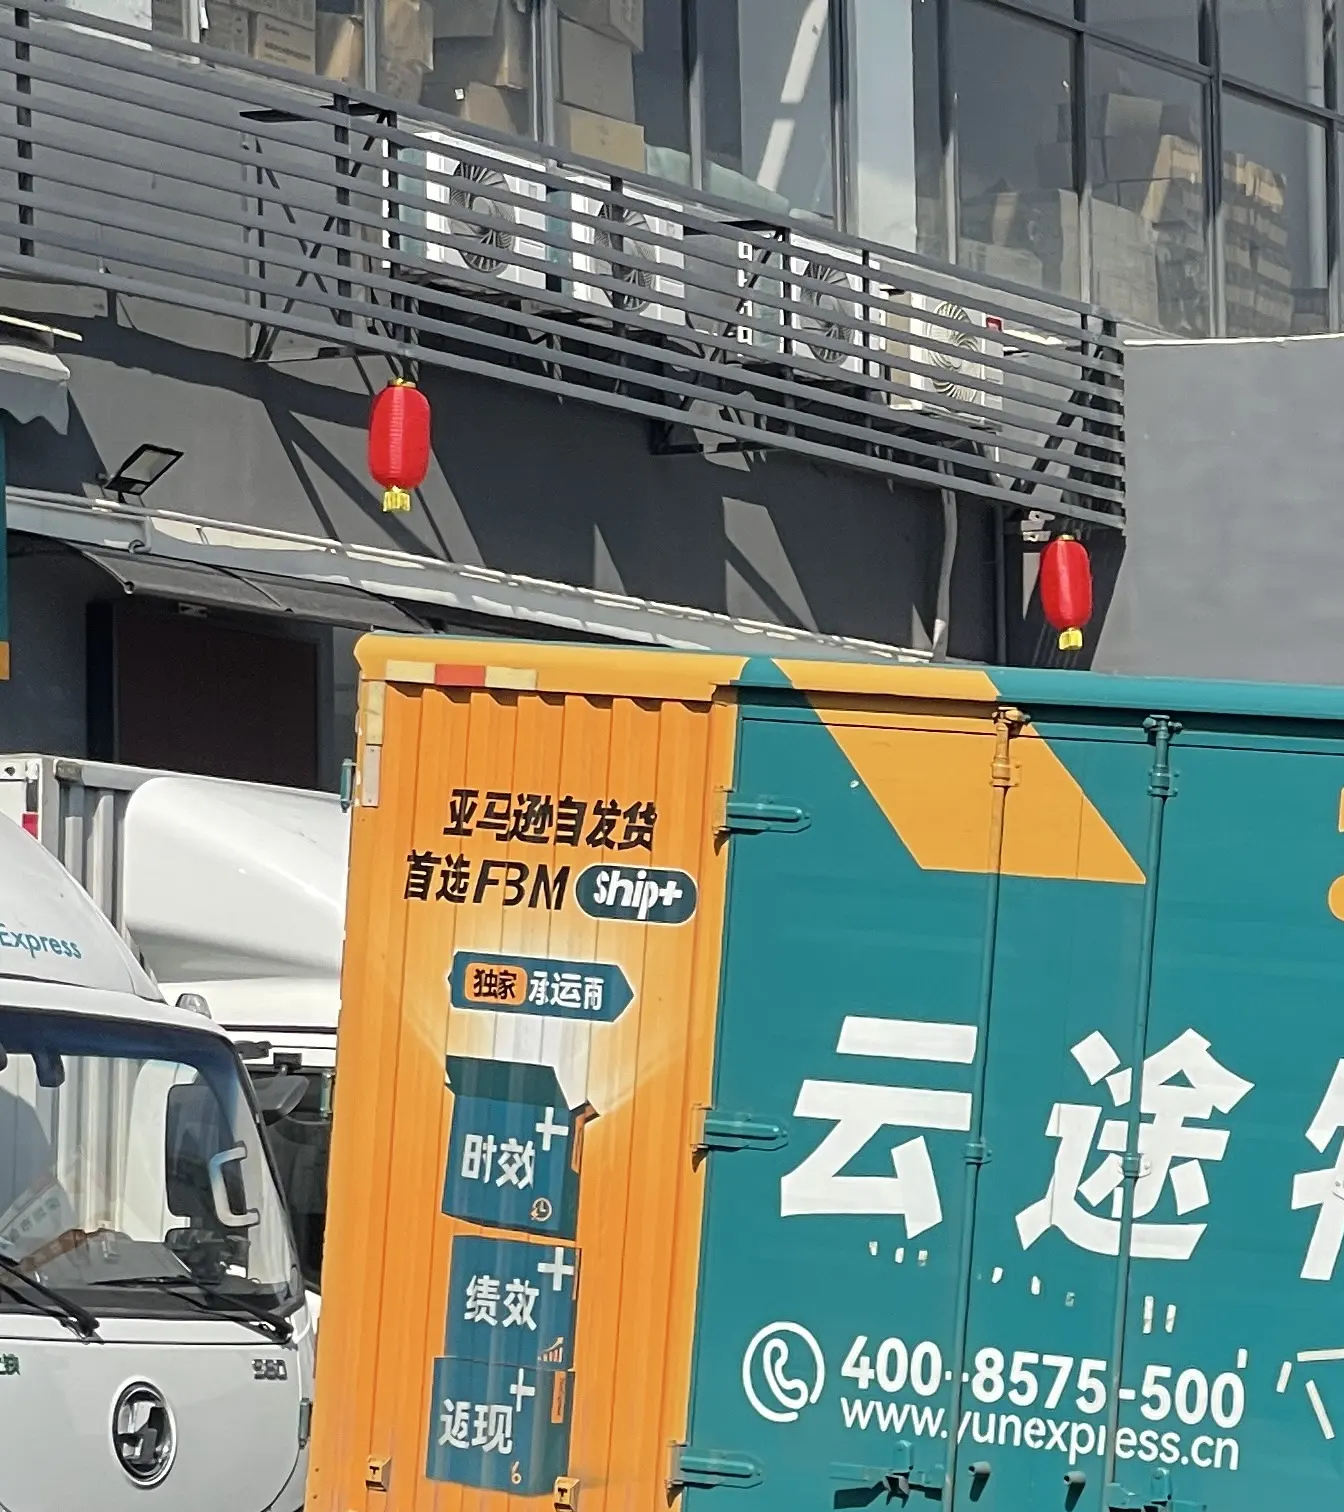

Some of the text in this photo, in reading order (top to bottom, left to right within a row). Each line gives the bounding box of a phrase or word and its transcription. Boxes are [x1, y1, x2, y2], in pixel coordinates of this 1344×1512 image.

[442, 788, 659, 852] 亚马逊自发货
[841, 1335, 1246, 1429] 400-8575-500
[840, 1396, 1240, 1471] www.yunexpress.cn
